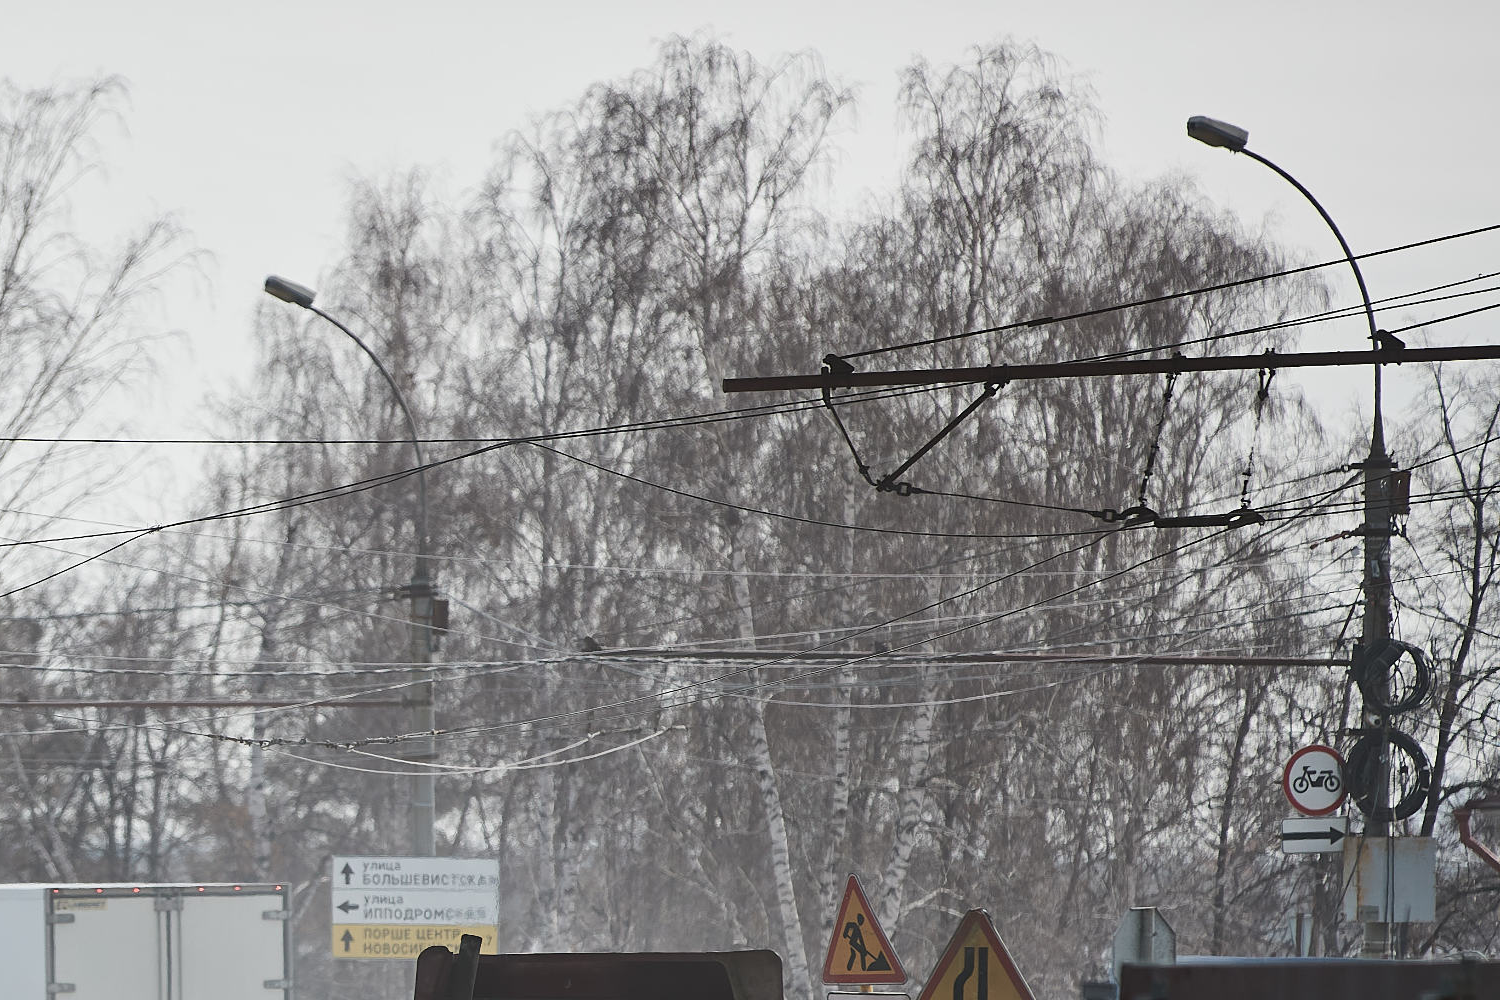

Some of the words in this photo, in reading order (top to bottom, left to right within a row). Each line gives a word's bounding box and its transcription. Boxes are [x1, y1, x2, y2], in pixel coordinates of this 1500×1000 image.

[363, 861, 401, 873] улица
[364, 895, 403, 906] улица
[363, 907, 487, 920] ИППОДРОМС
[363, 928, 411, 940] ПОРШЕ
[417, 929, 461, 940] ЦЕНТР
